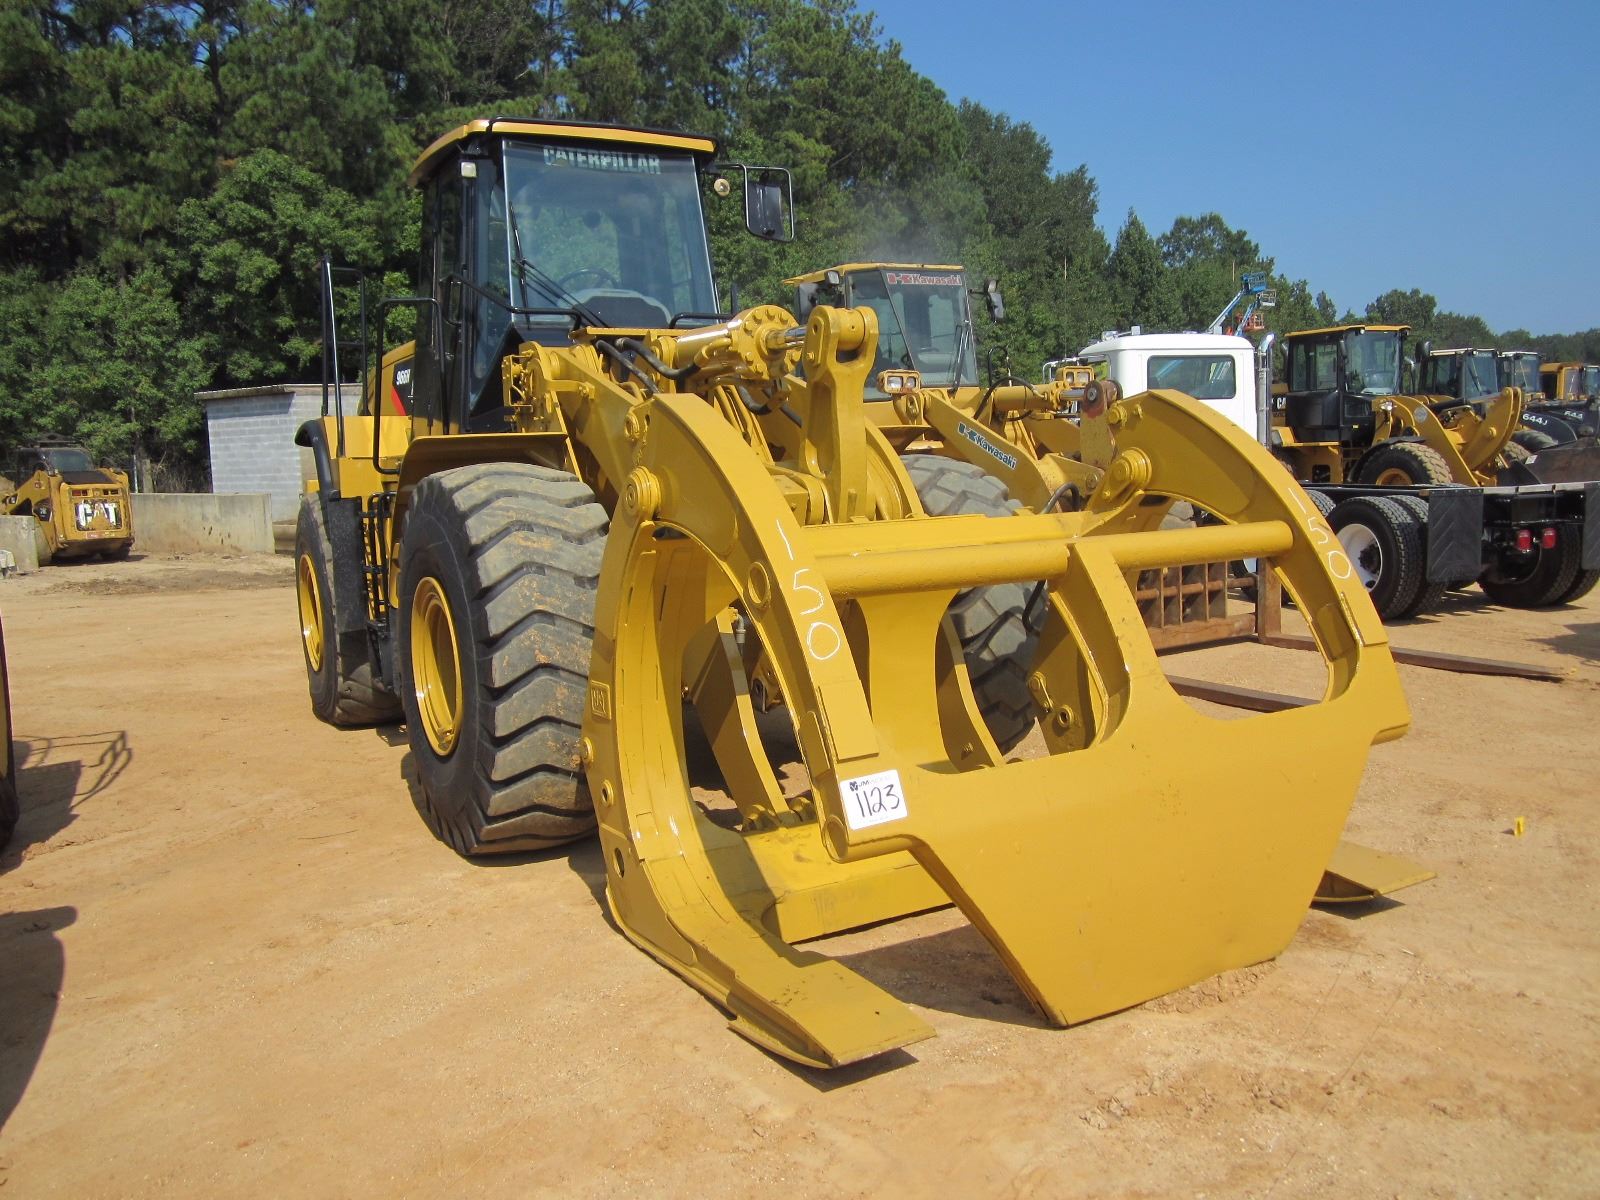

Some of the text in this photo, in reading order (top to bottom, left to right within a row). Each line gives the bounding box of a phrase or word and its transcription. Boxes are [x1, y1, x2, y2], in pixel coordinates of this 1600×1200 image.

[543, 145, 661, 175] CATERPILLAR
[911, 273, 962, 286] Kawasaki
[1276, 397, 1287, 410] CA
[1522, 413, 1548, 426] 644J
[974, 433, 1017, 470] Kawasaki
[78, 500, 117, 528] CAT
[855, 783, 900, 818] 1123
